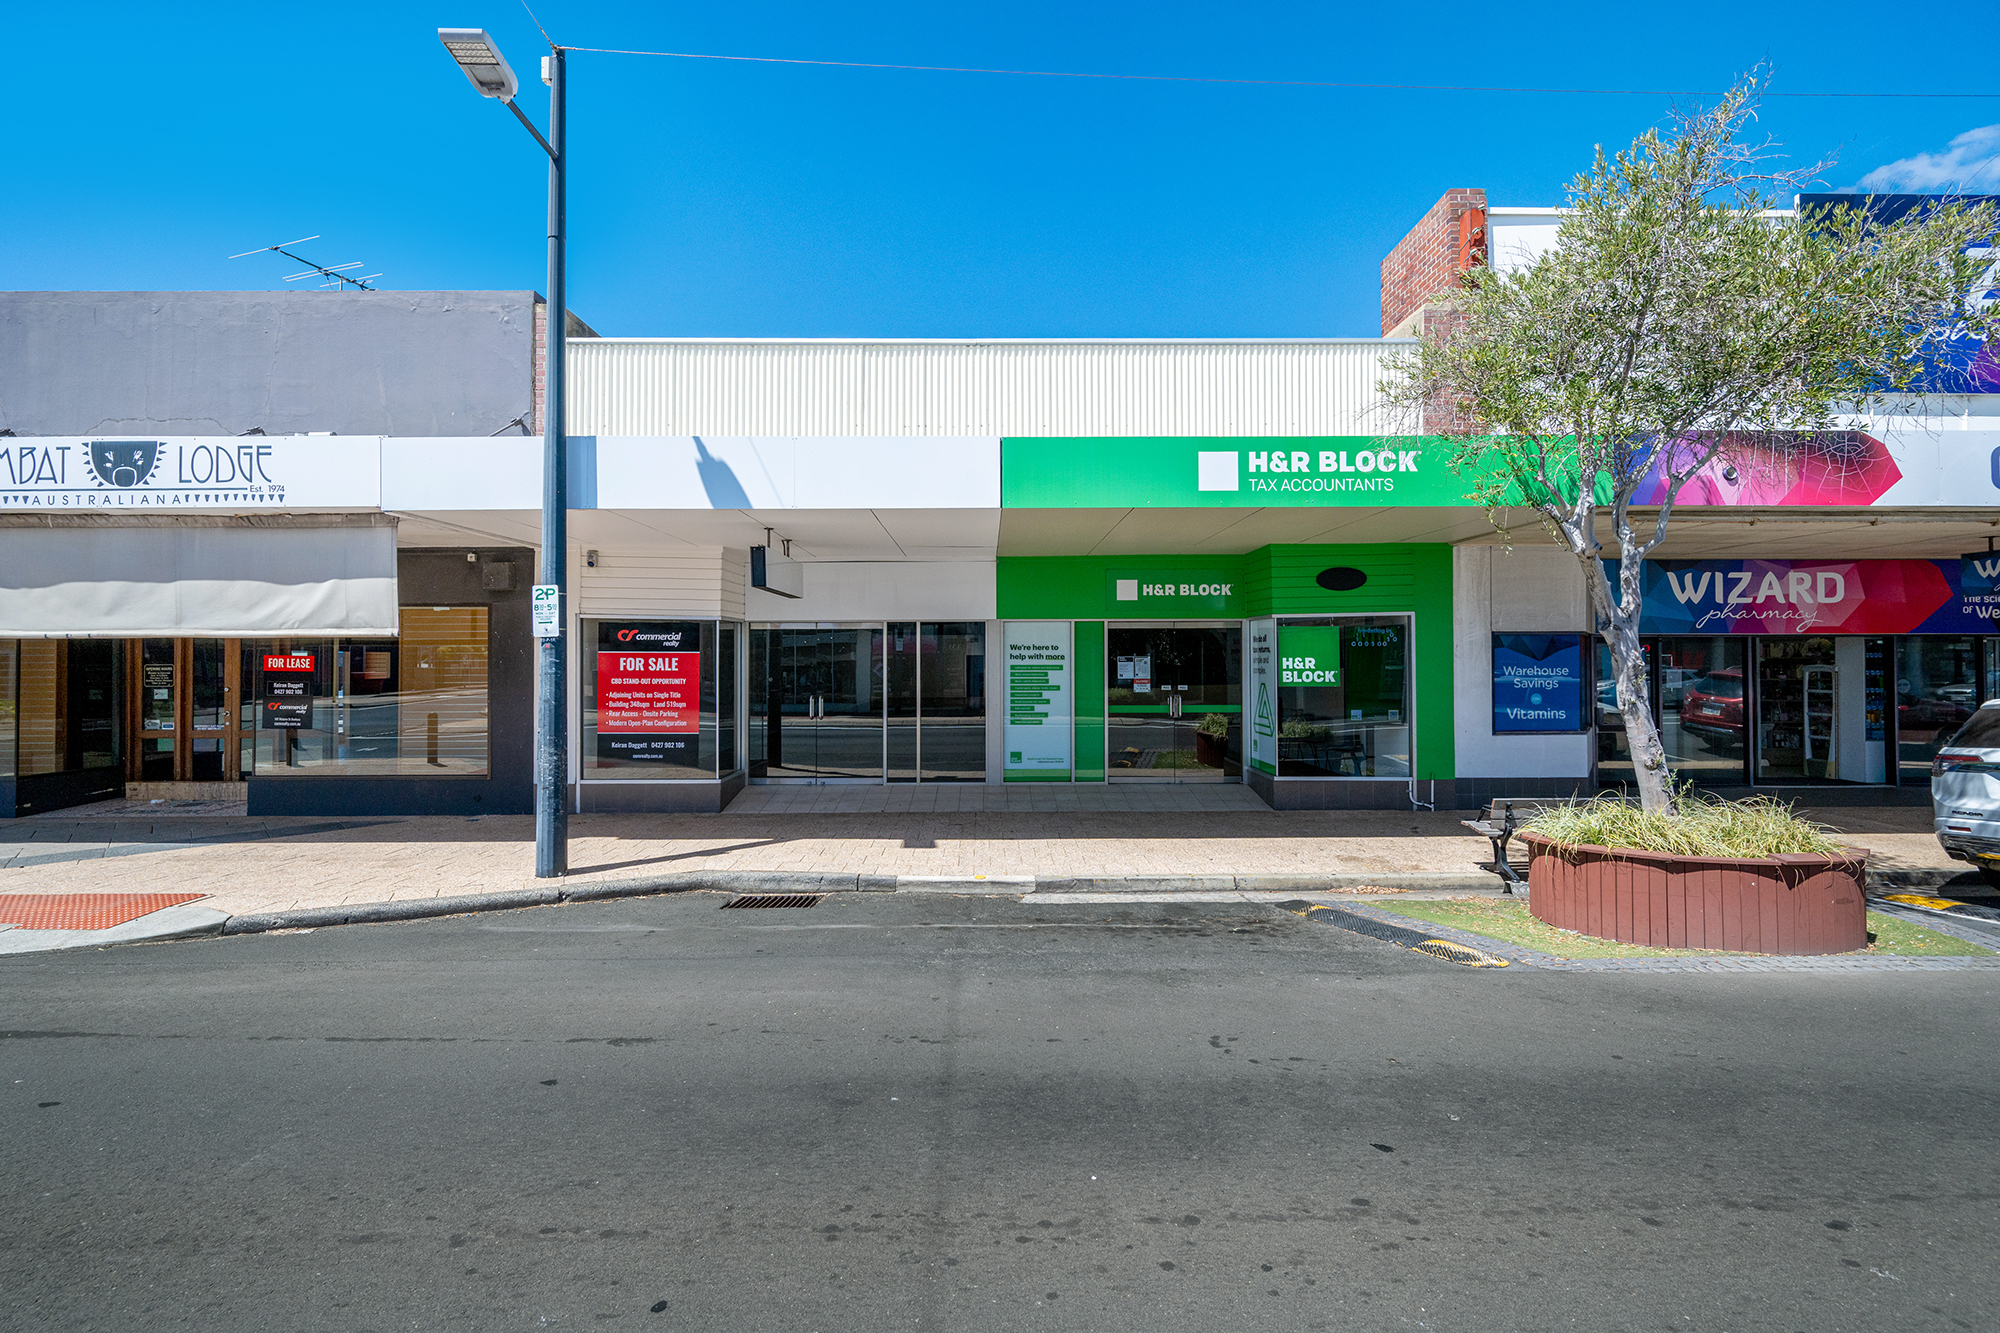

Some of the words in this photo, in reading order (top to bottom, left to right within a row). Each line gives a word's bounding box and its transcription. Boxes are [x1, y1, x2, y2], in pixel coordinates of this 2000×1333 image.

[179, 445, 272, 483] LODGE
[1249, 451, 1310, 472] H&R
[1249, 479, 1277, 491] TAX
[1281, 478, 1394, 491] ACCOUNTANTS
[32, 494, 181, 505] AUSTRALIANA
[1143, 584, 1175, 596] H&R
[1180, 584, 1232, 596] BLOCK
[1667, 571, 1845, 604] WIZARD
[535, 588, 555, 600] 2P
[1962, 606, 1973, 614] of
[1696, 601, 1823, 632] pharmacy
[636, 632, 682, 641] commercial
[663, 640, 680, 648] realty
[1010, 653, 1026, 661] help
[268, 658, 284, 668] FOR
[286, 658, 310, 668] LEASE
[620, 657, 644, 671] FOR
[648, 657, 678, 671] SALE
[1282, 657, 1316, 669] H&R
[1283, 671, 1336, 682] BLOCK
[1503, 666, 1569, 676] Warehouse
[1514, 678, 1559, 690] Savings
[660, 710, 678, 718] Parking
[1507, 708, 1566, 719] Vitamins
